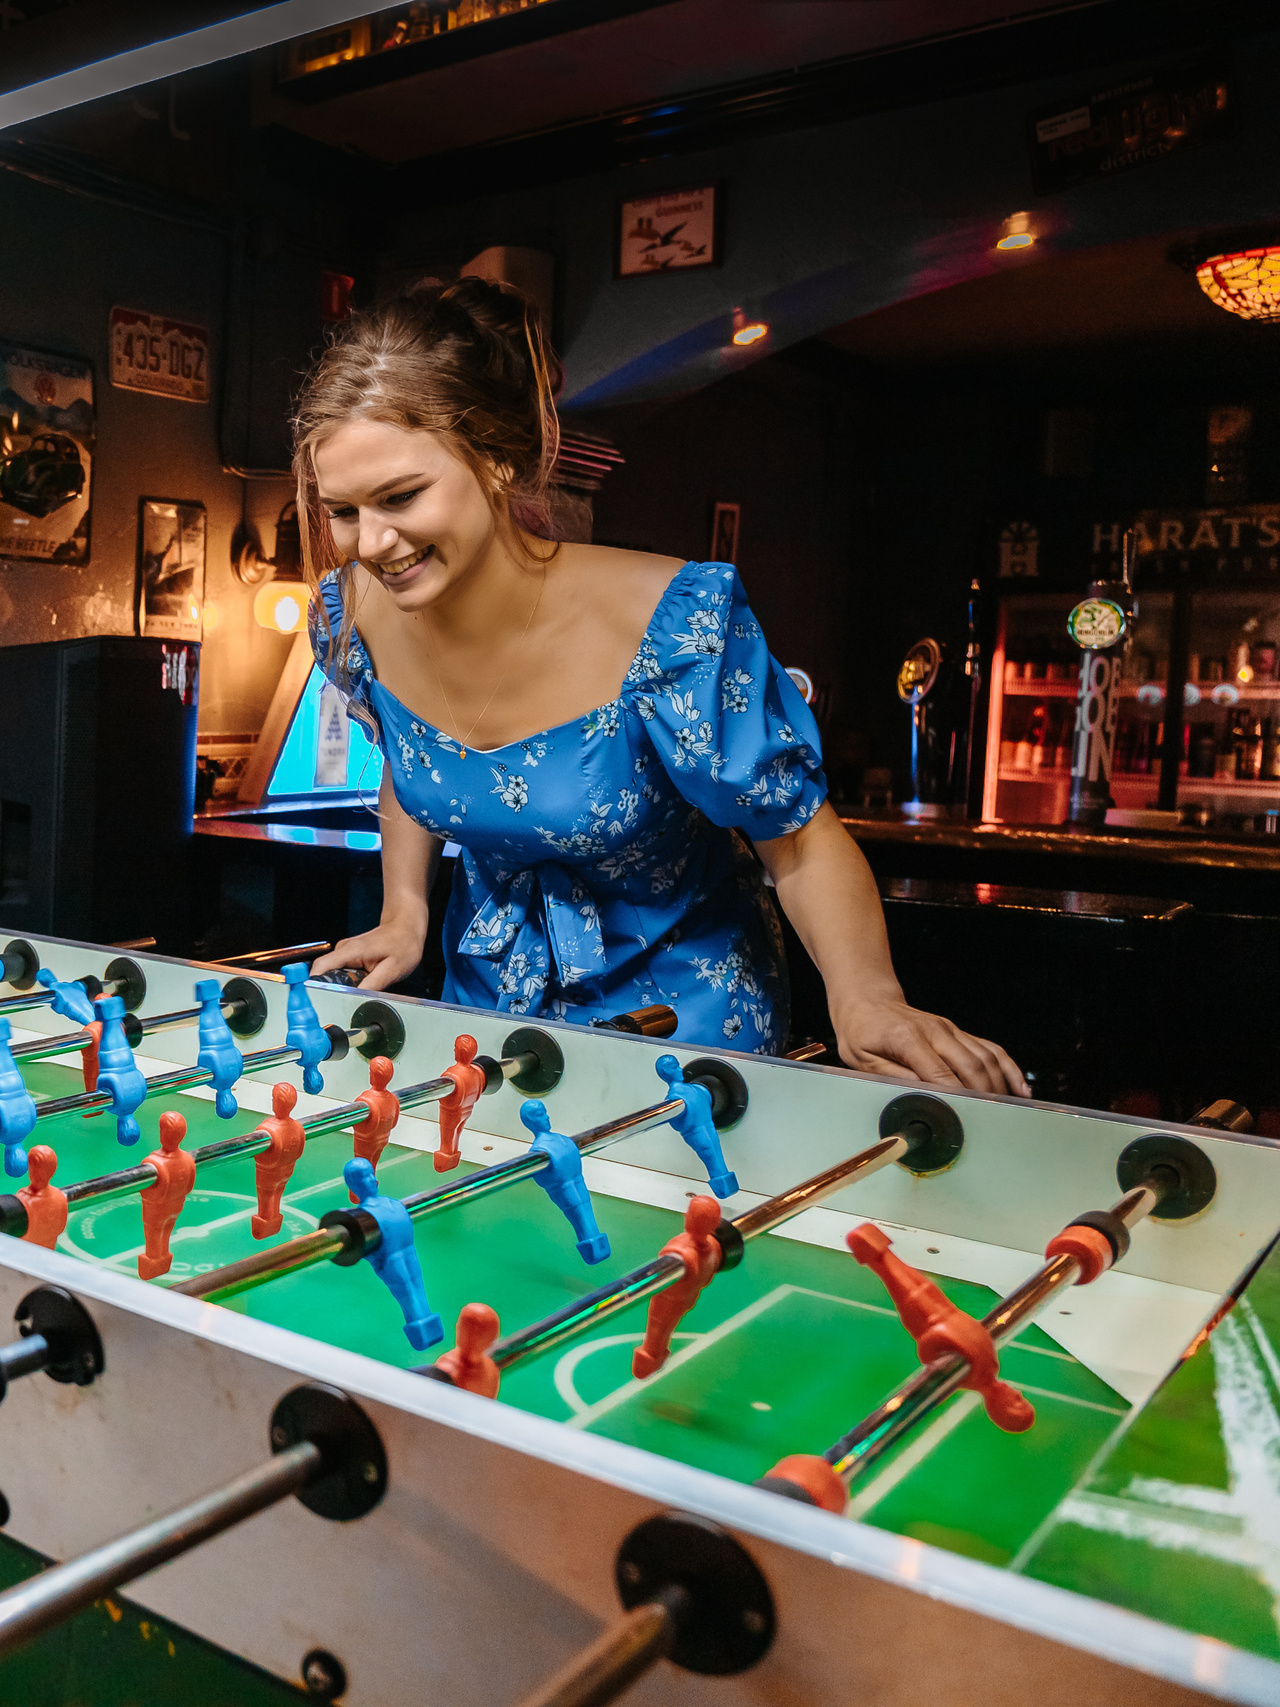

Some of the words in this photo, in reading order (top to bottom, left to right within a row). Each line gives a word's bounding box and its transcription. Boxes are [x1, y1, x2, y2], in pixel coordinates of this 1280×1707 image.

[1099, 140, 1169, 171] district
[655, 200, 703, 218] GUINNESS
[16, 538, 56, 553] BEETLE
